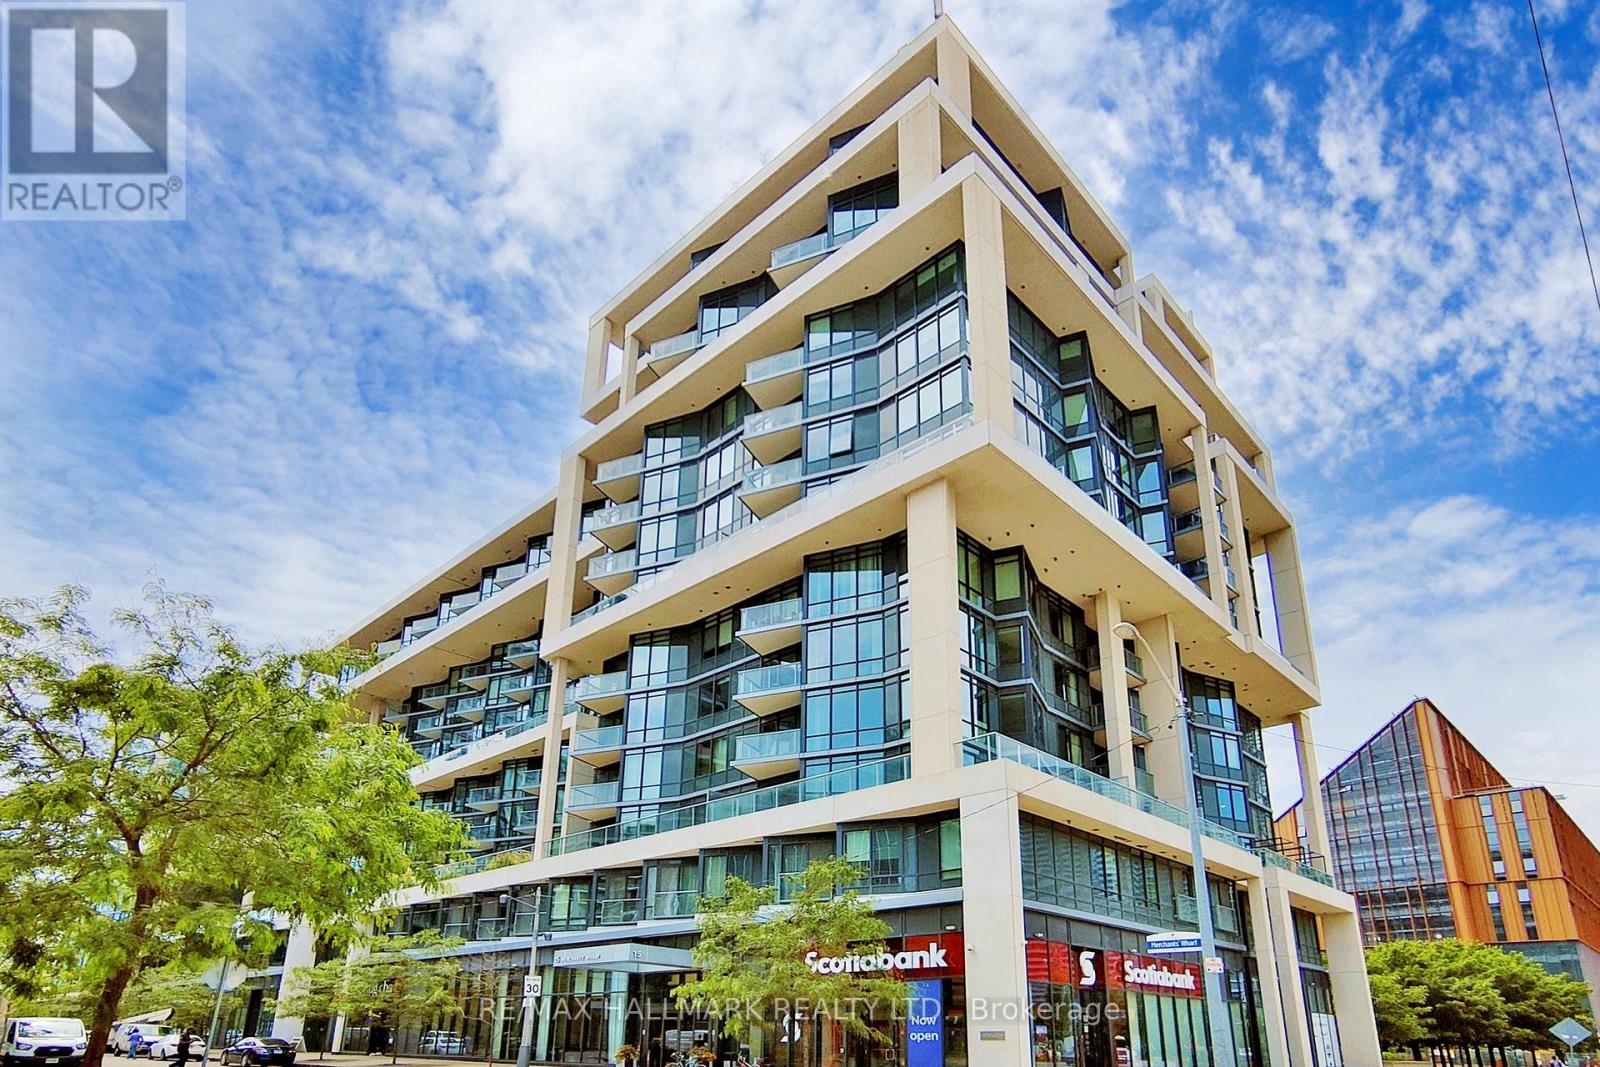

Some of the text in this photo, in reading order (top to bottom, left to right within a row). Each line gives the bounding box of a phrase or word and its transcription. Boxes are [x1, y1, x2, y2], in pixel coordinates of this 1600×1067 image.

[632, 950, 642, 959] 15
[805, 943, 948, 975] Scotiabank
[1124, 960, 1195, 989] Scotiabank
[526, 983, 540, 994] 30
[911, 1015, 936, 1026] Now
[909, 1031, 939, 1042] open
